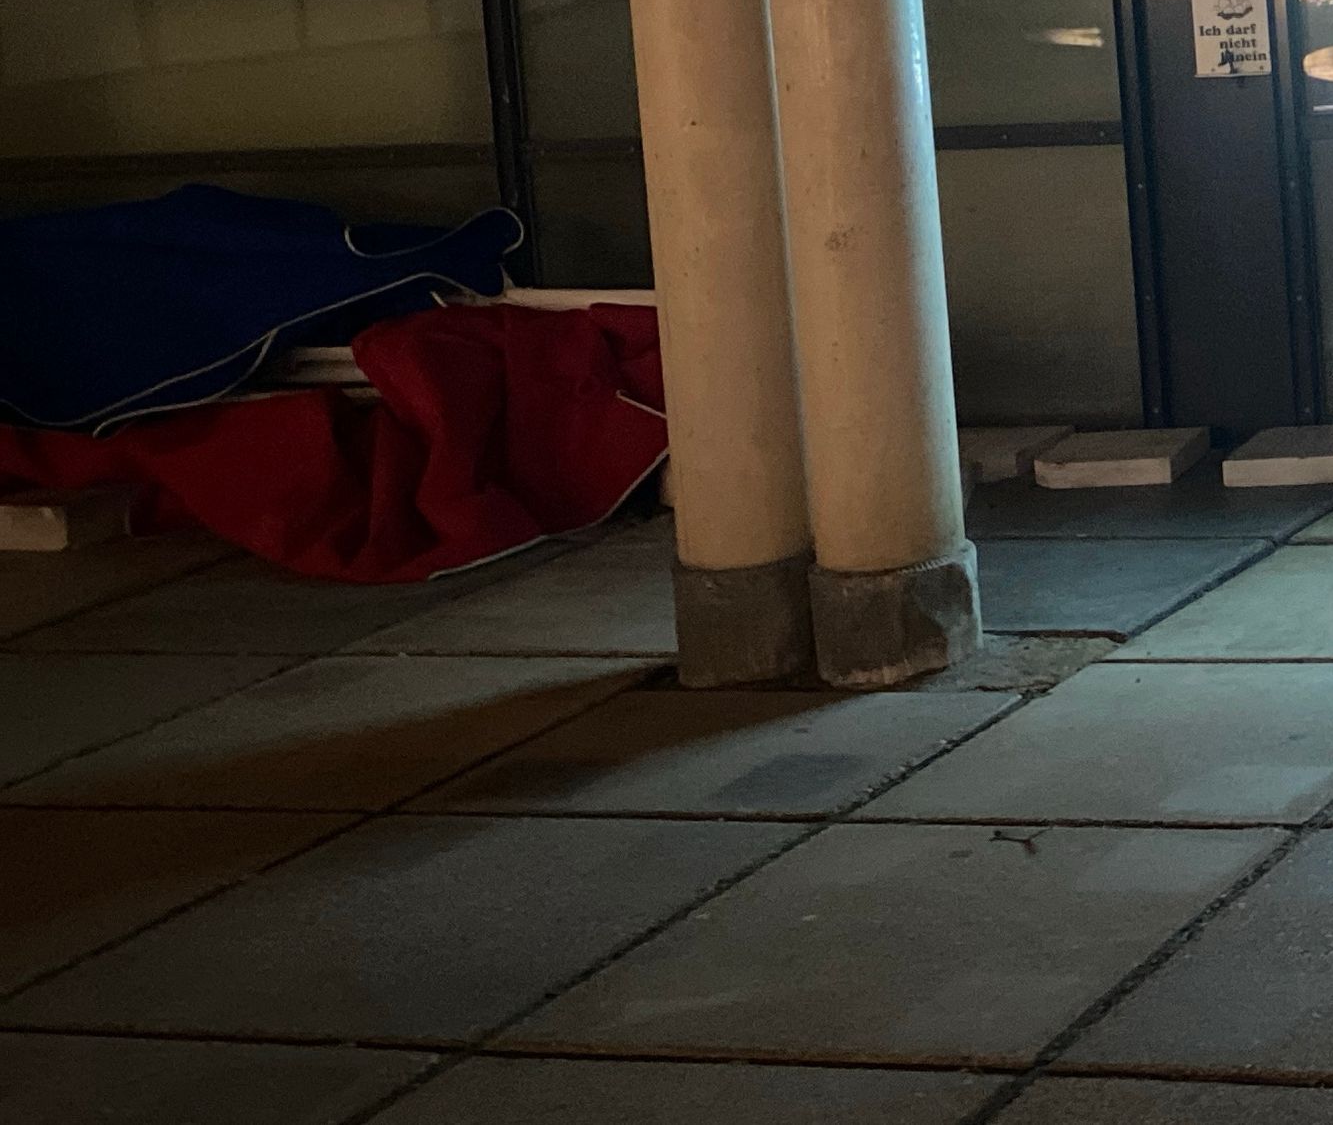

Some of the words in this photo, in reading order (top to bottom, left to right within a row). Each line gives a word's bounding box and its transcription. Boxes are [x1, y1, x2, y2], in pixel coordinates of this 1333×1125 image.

[1199, 25, 1221, 36] Ich
[1226, 23, 1256, 35] darf
[1220, 38, 1257, 49] nicht
[1221, 50, 1267, 63] nein
